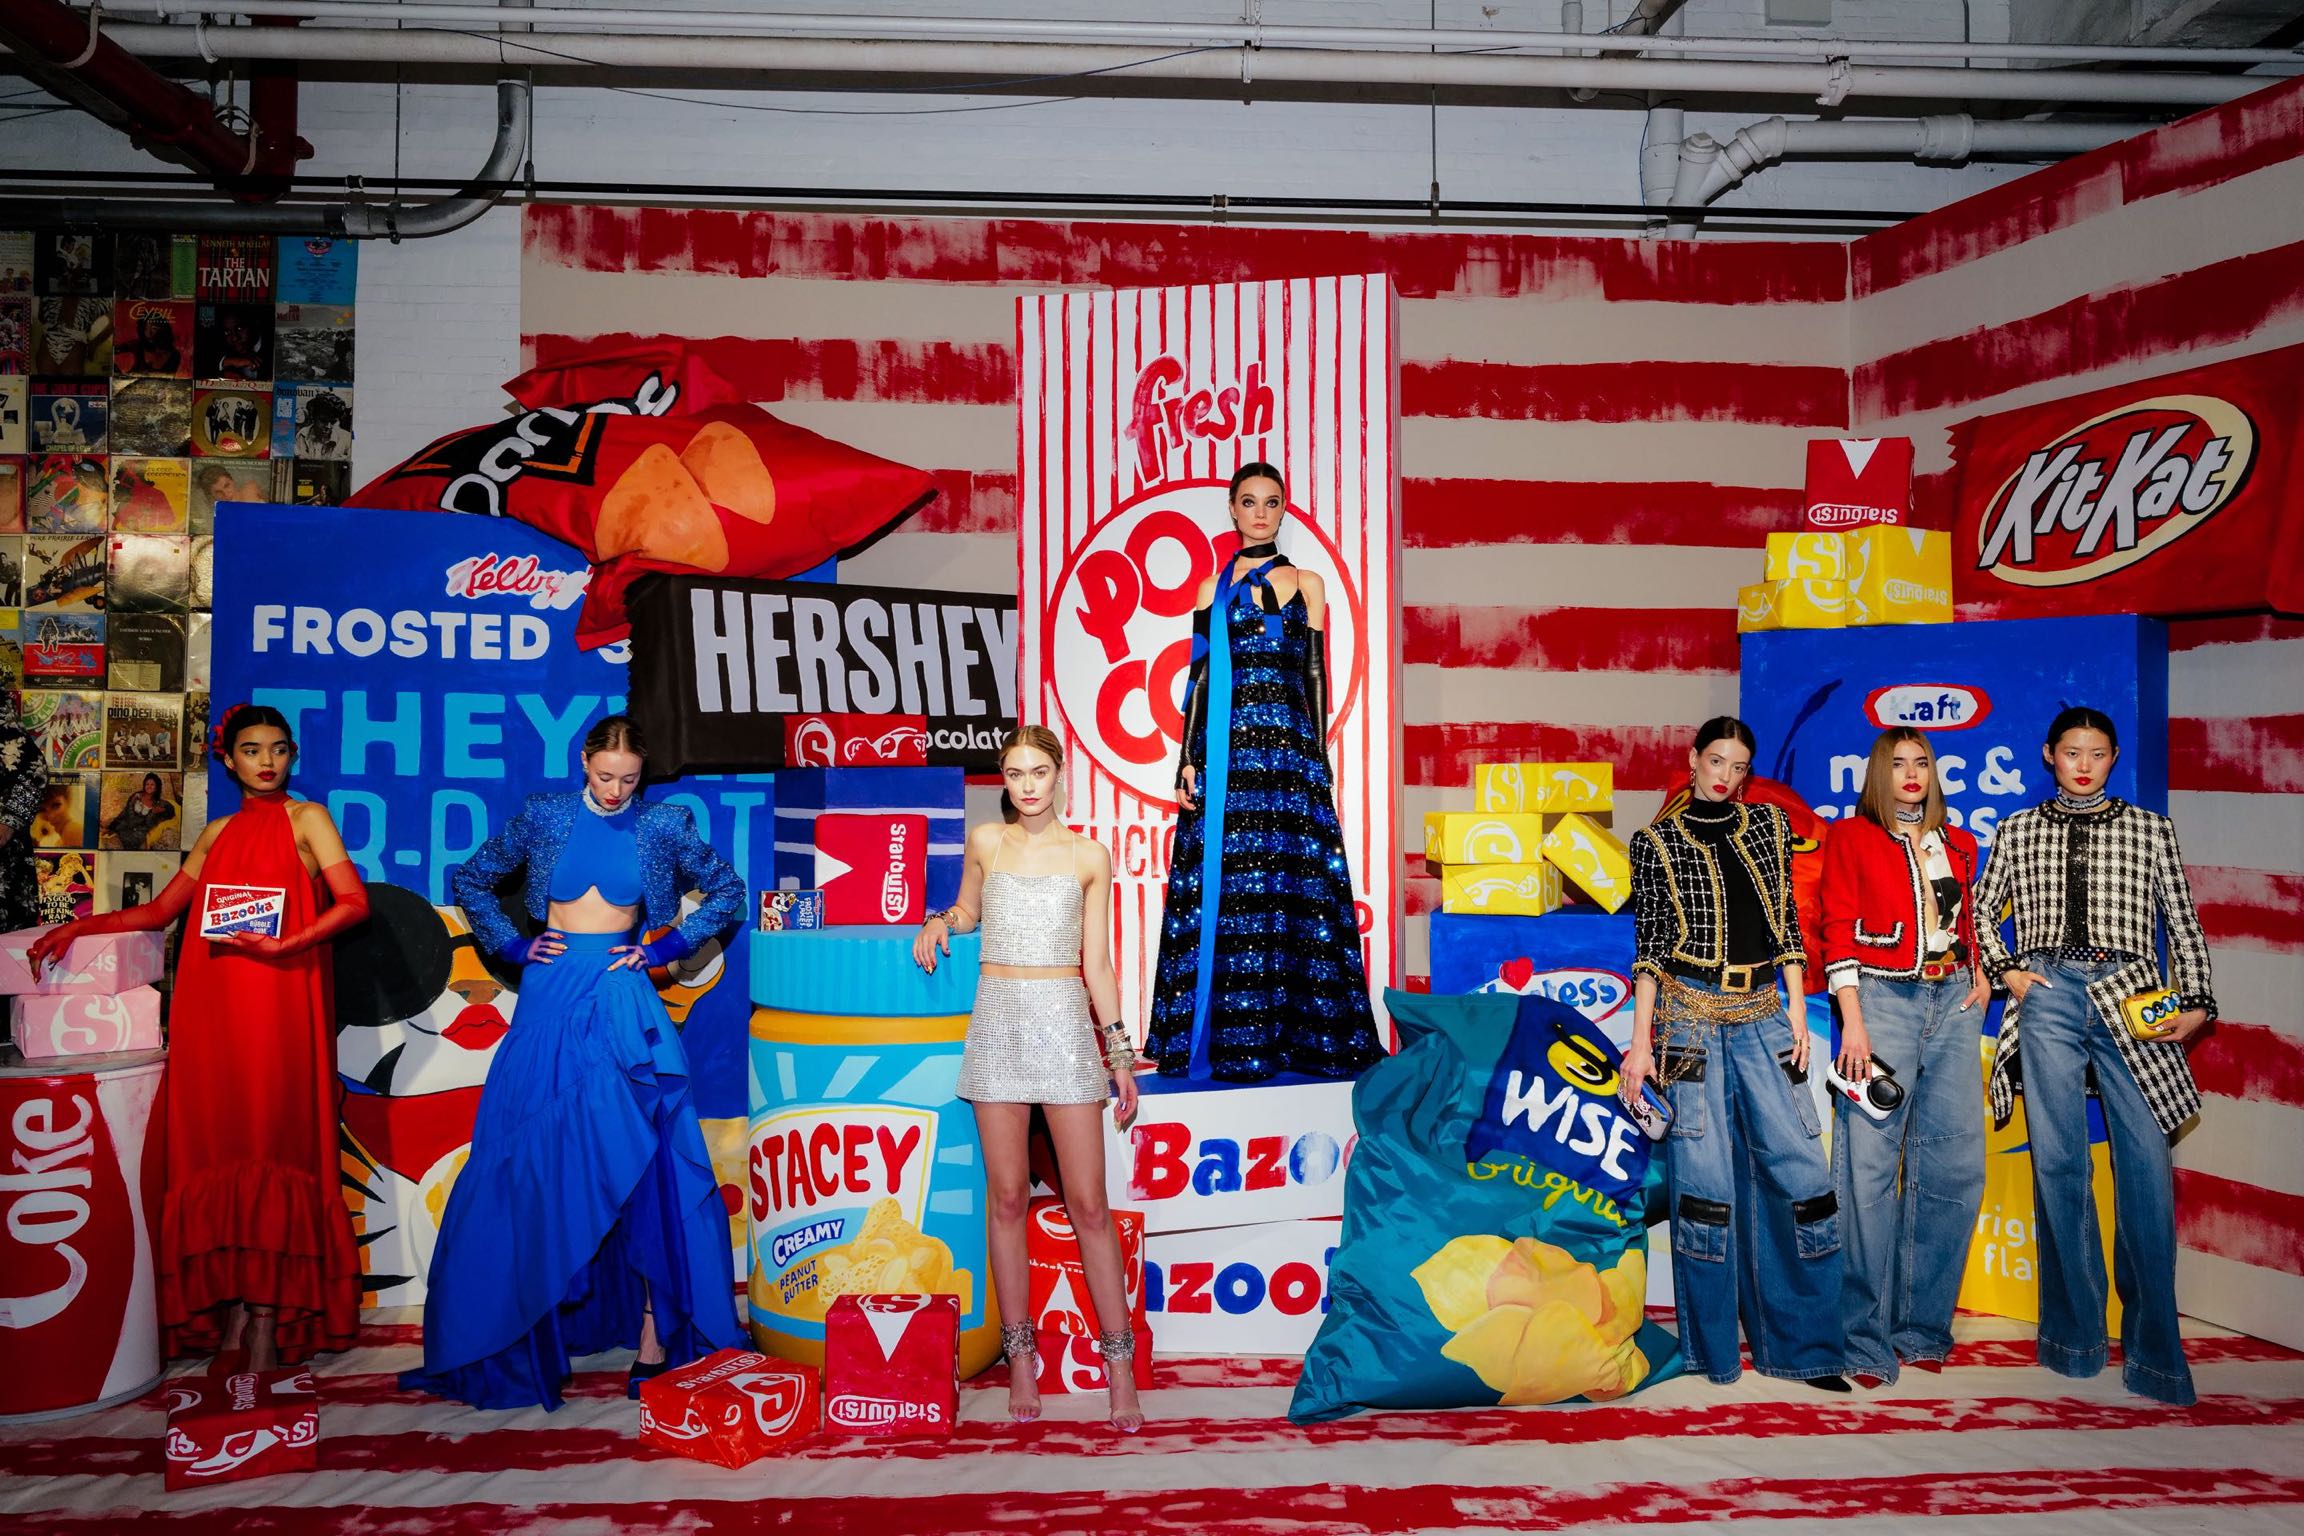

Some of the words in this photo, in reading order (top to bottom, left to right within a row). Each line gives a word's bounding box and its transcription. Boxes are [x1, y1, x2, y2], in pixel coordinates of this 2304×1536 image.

[199, 267, 271, 288] TARTAN
[224, 257, 245, 268] THE
[1126, 356, 1273, 478] fresh
[1815, 506, 1898, 524] Starburst
[252, 604, 550, 660] FROSTED
[252, 688, 627, 778] THEY'
[1830, 754, 1967, 795] mc
[1978, 746, 2026, 796] &
[887, 823, 907, 913] Starburst
[40, 908, 55, 916] THE
[56, 908, 75, 917] KING
[53, 895, 76, 904] GOOD
[216, 891, 253, 904] ORIGINAL
[804, 897, 814, 928] FROSTED
[210, 901, 274, 926] Bazooka
[250, 920, 271, 928] BUBBLE
[1502, 1070, 1640, 1180] WISE
[749, 1122, 921, 1222] STACEY
[773, 1219, 843, 1267] CREAMY
[780, 1260, 816, 1290] PEANUT
[1984, 1243, 2038, 1281] fla
[784, 1273, 818, 1304] BUTTER
[837, 1401, 941, 1423] Starburst
